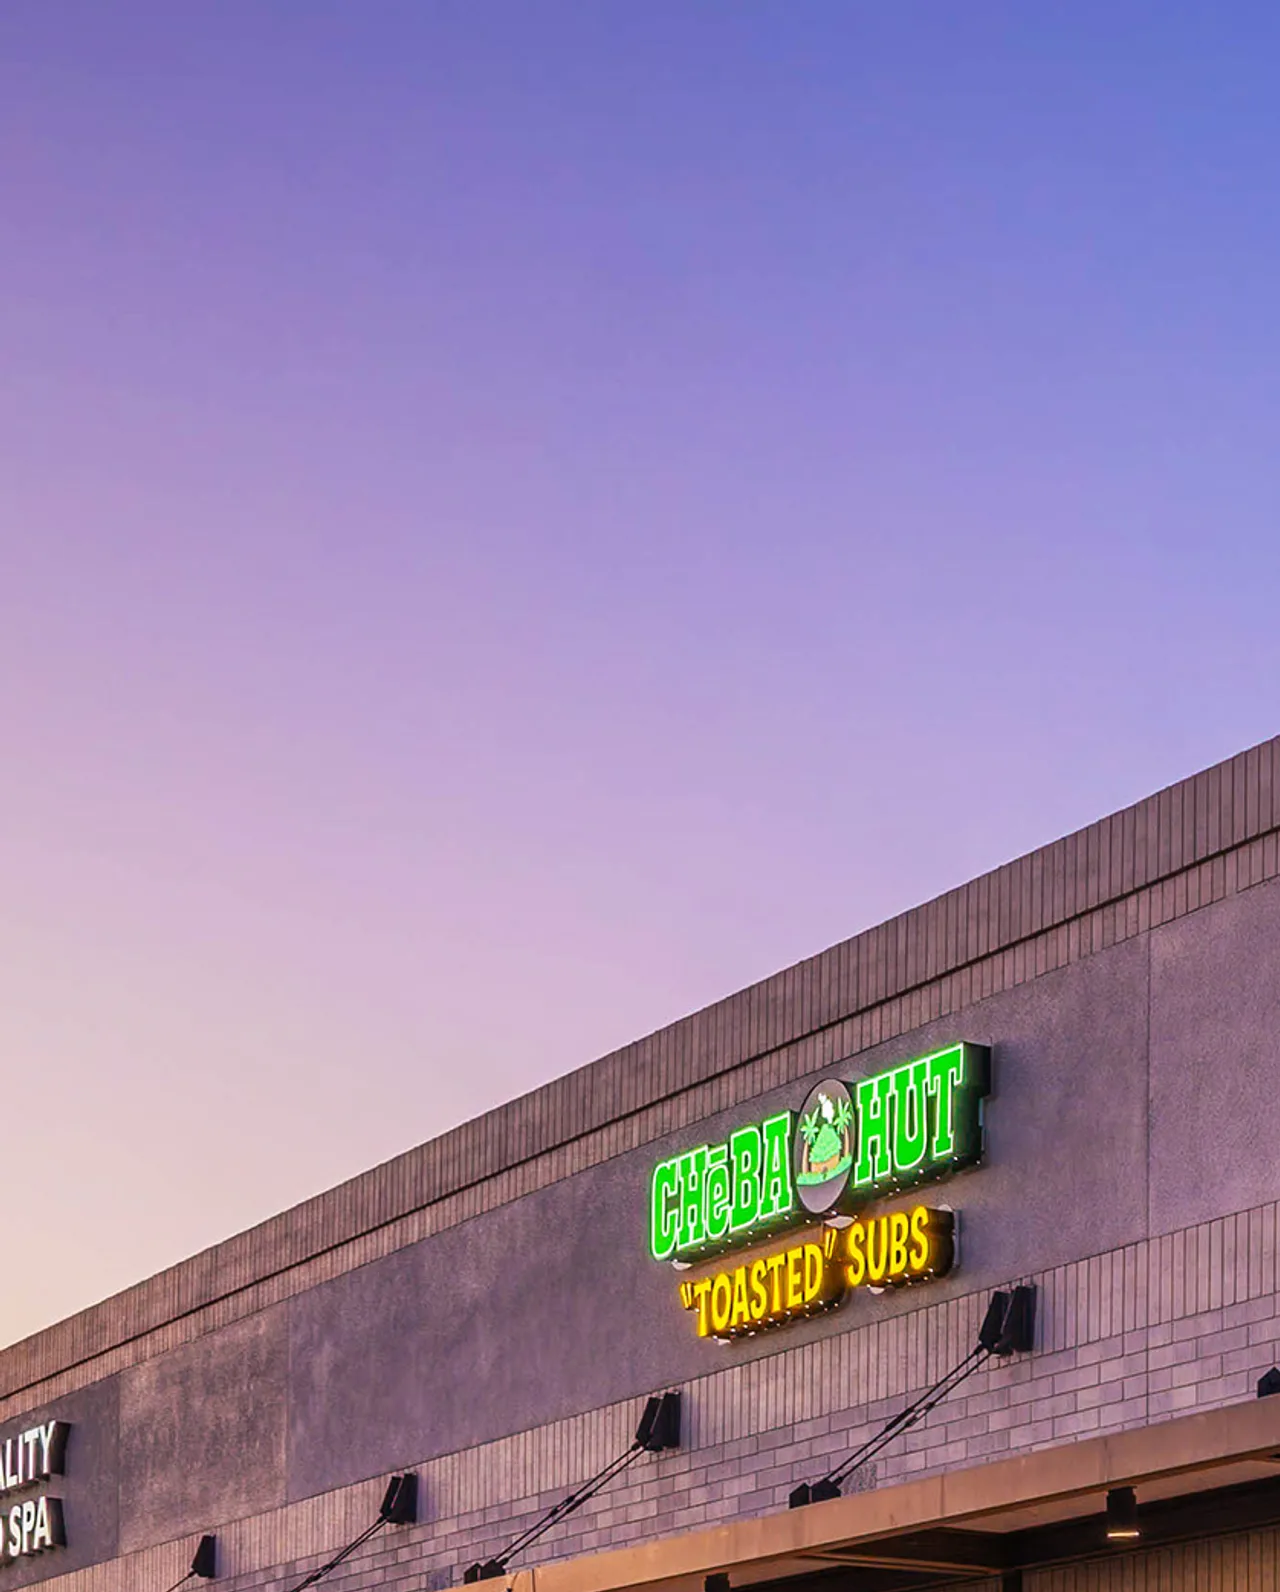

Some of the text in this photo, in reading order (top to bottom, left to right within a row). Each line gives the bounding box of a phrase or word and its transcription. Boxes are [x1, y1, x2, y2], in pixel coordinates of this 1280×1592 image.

[853, 1043, 965, 1186] HUT
[680, 1205, 930, 1338] "TOASTED" SUBS
[0, 1420, 56, 1490] LITY
[9, 1496, 52, 1556] SPA
